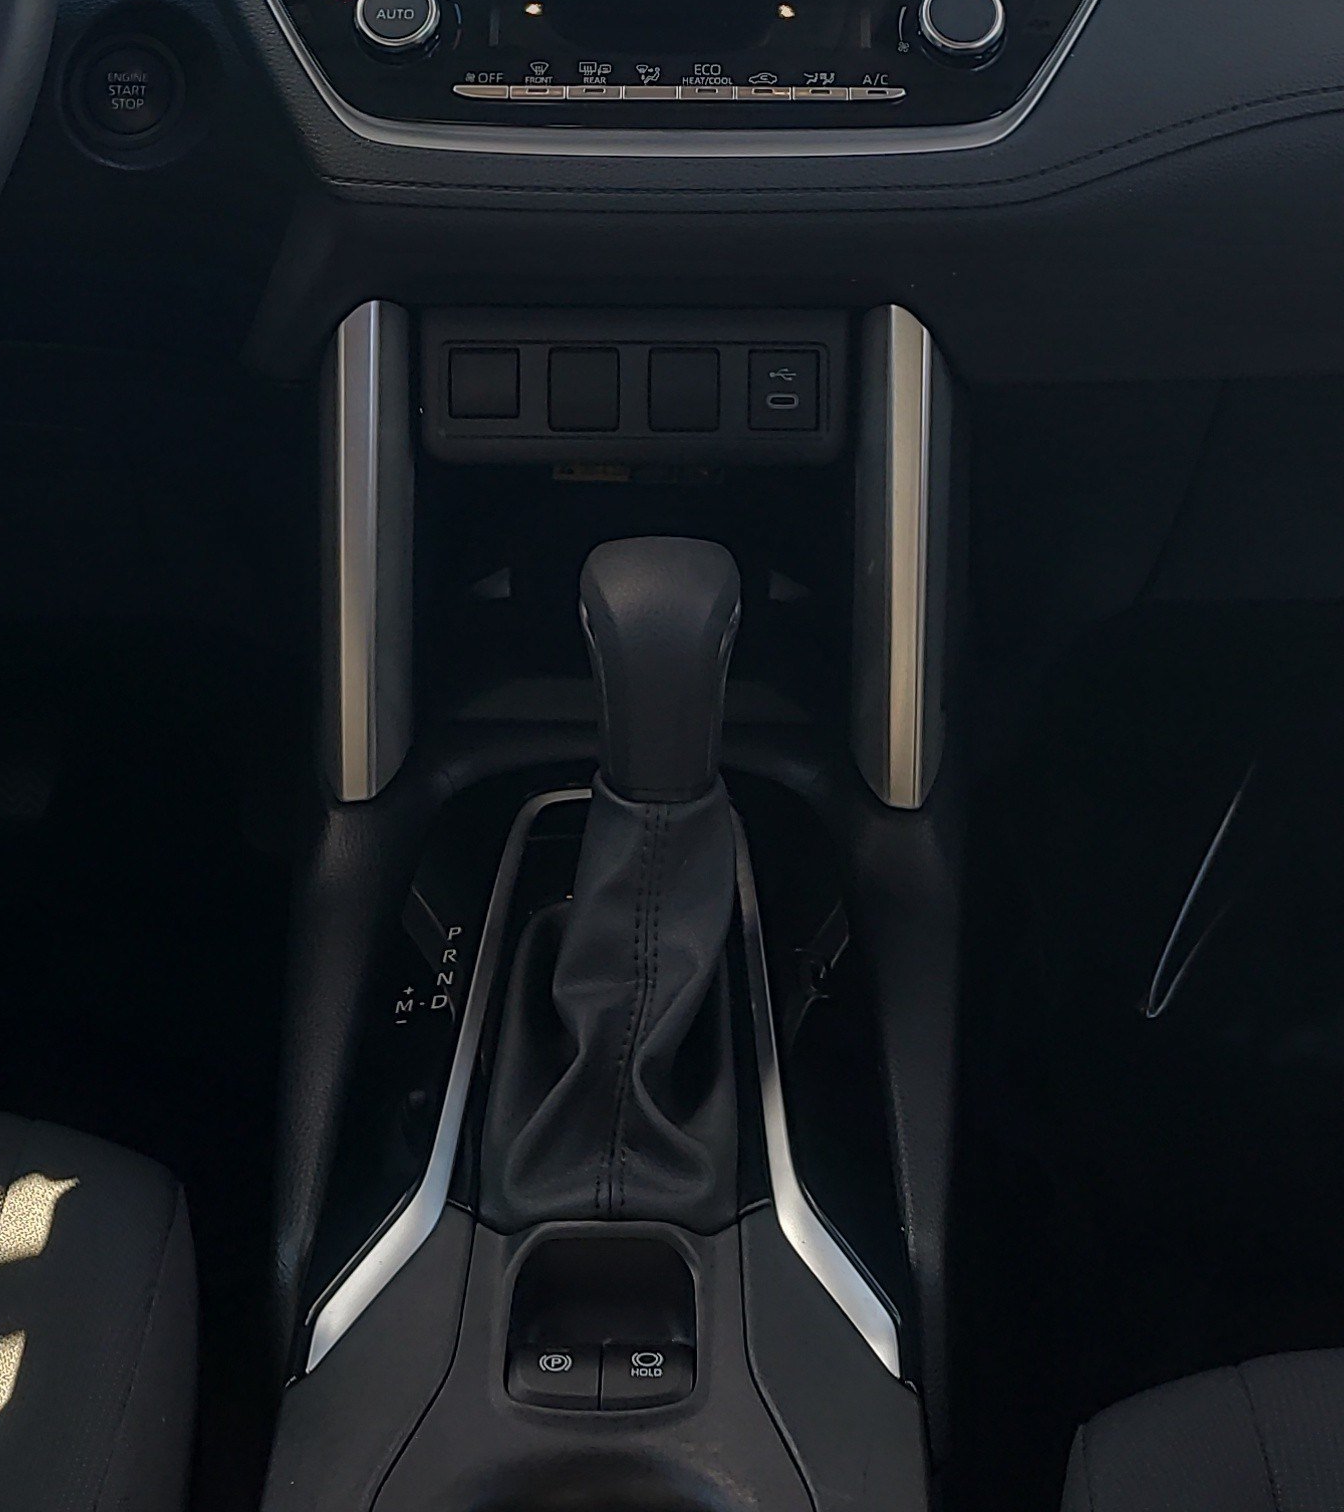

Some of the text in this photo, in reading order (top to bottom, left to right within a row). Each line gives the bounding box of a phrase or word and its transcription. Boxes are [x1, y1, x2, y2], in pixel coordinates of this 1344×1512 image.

[376, 8, 415, 20] AUTO
[694, 64, 721, 76] ECO
[107, 72, 149, 83] ENGINE
[478, 73, 504, 83] OFF
[525, 76, 553, 84] FRONT
[583, 76, 606, 84] REAR
[682, 76, 733, 86] HEAT/COOL
[862, 74, 888, 85] A/C
[109, 85, 147, 96] START
[112, 98, 144, 110] STOP
[447, 927, 462, 941] P
[442, 949, 457, 963] R
[437, 971, 454, 986] N
[395, 995, 448, 1014] M D
[631, 1368, 662, 1377] HOLD
